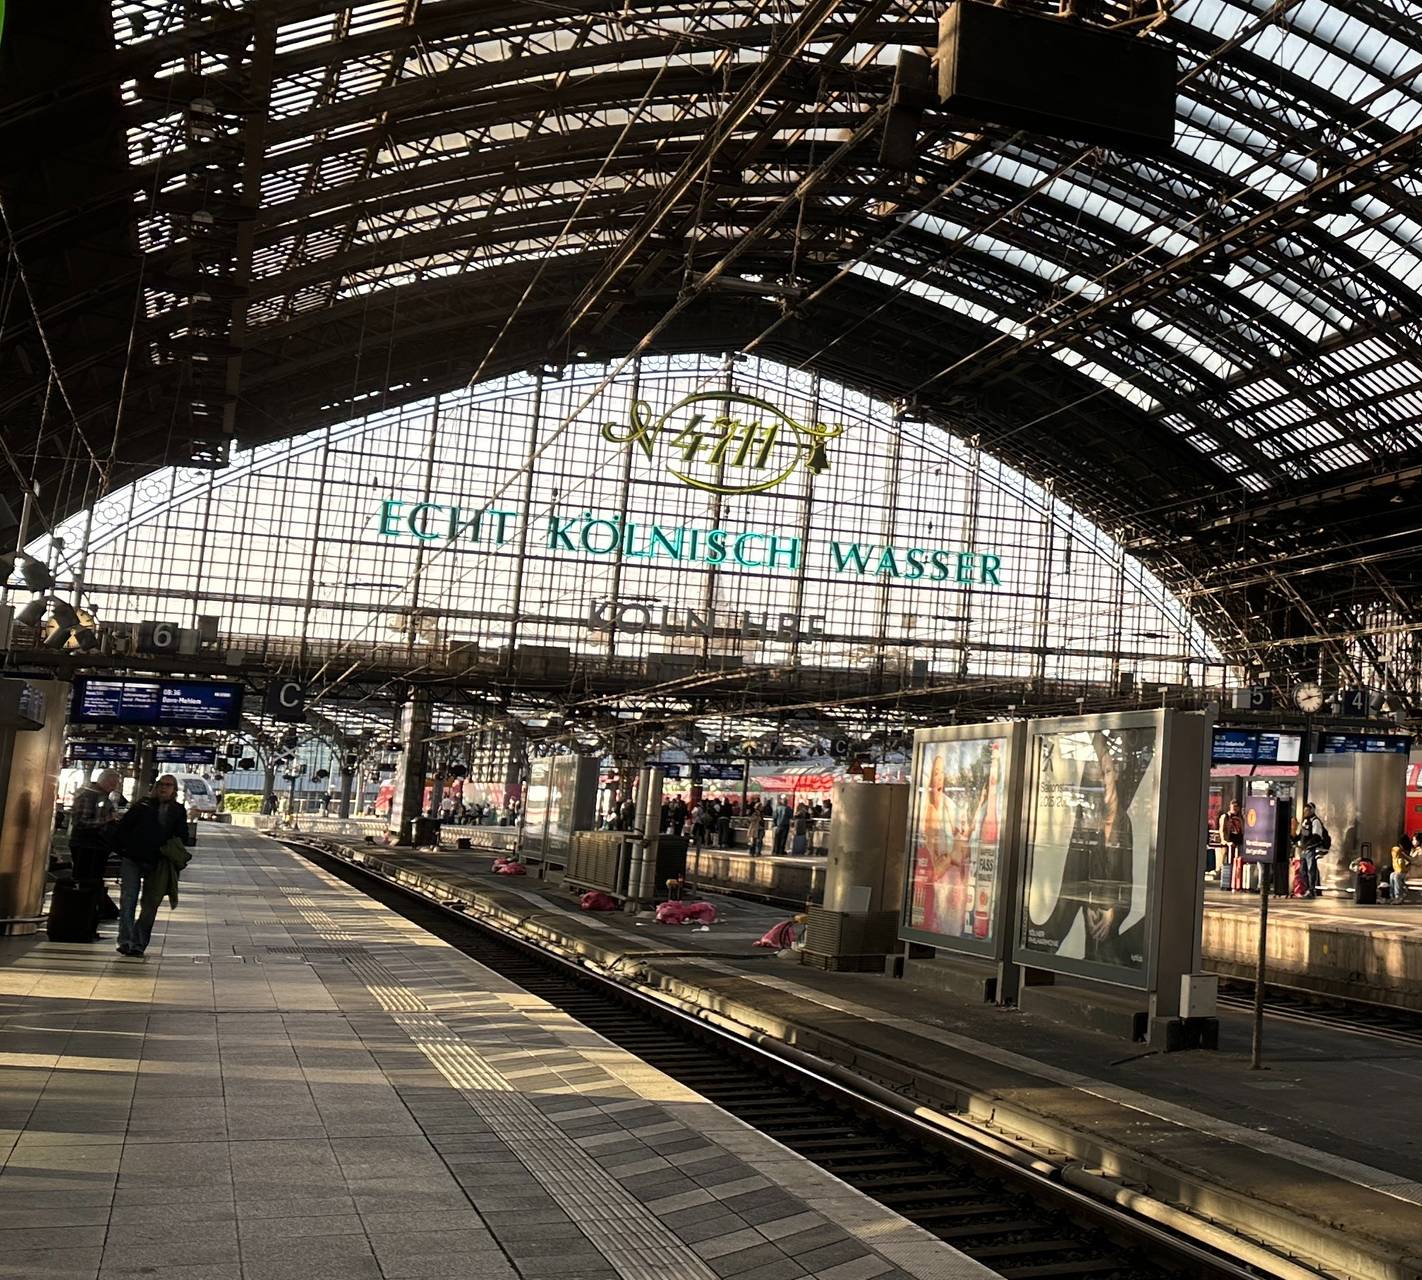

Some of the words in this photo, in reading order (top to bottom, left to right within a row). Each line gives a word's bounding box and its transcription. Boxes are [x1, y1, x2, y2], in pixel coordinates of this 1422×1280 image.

[669, 414, 779, 470] 4711
[377, 499, 517, 545] ECHT
[549, 511, 801, 570] KÖLNISCH
[830, 541, 1002, 587] WASSER
[587, 597, 714, 638] KÖLN
[740, 609, 826, 644] HBF
[153, 623, 172, 647] 6
[279, 682, 301, 708] C
[1252, 686, 1264, 705] 5
[1351, 691, 1363, 710] 4
[233, 745, 242, 756] B
[836, 739, 846, 753] C
[979, 858, 994, 872] FASS
